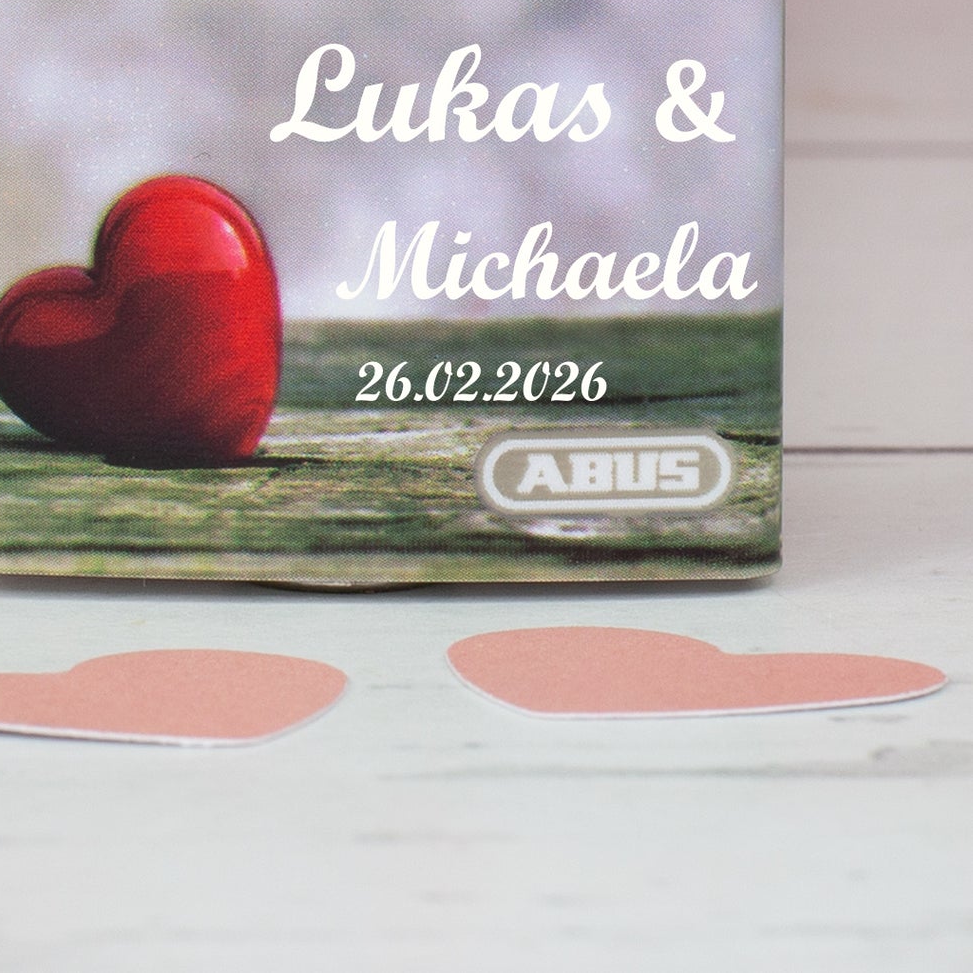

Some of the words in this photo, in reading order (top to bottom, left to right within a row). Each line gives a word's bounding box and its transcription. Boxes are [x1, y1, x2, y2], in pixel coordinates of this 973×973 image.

[269, 43, 612, 143] Lukas
[655, 59, 736, 143] &
[335, 220, 758, 300] Michaela
[355, 361, 608, 402] 26.02.2026
[516, 451, 701, 494] ABUS
